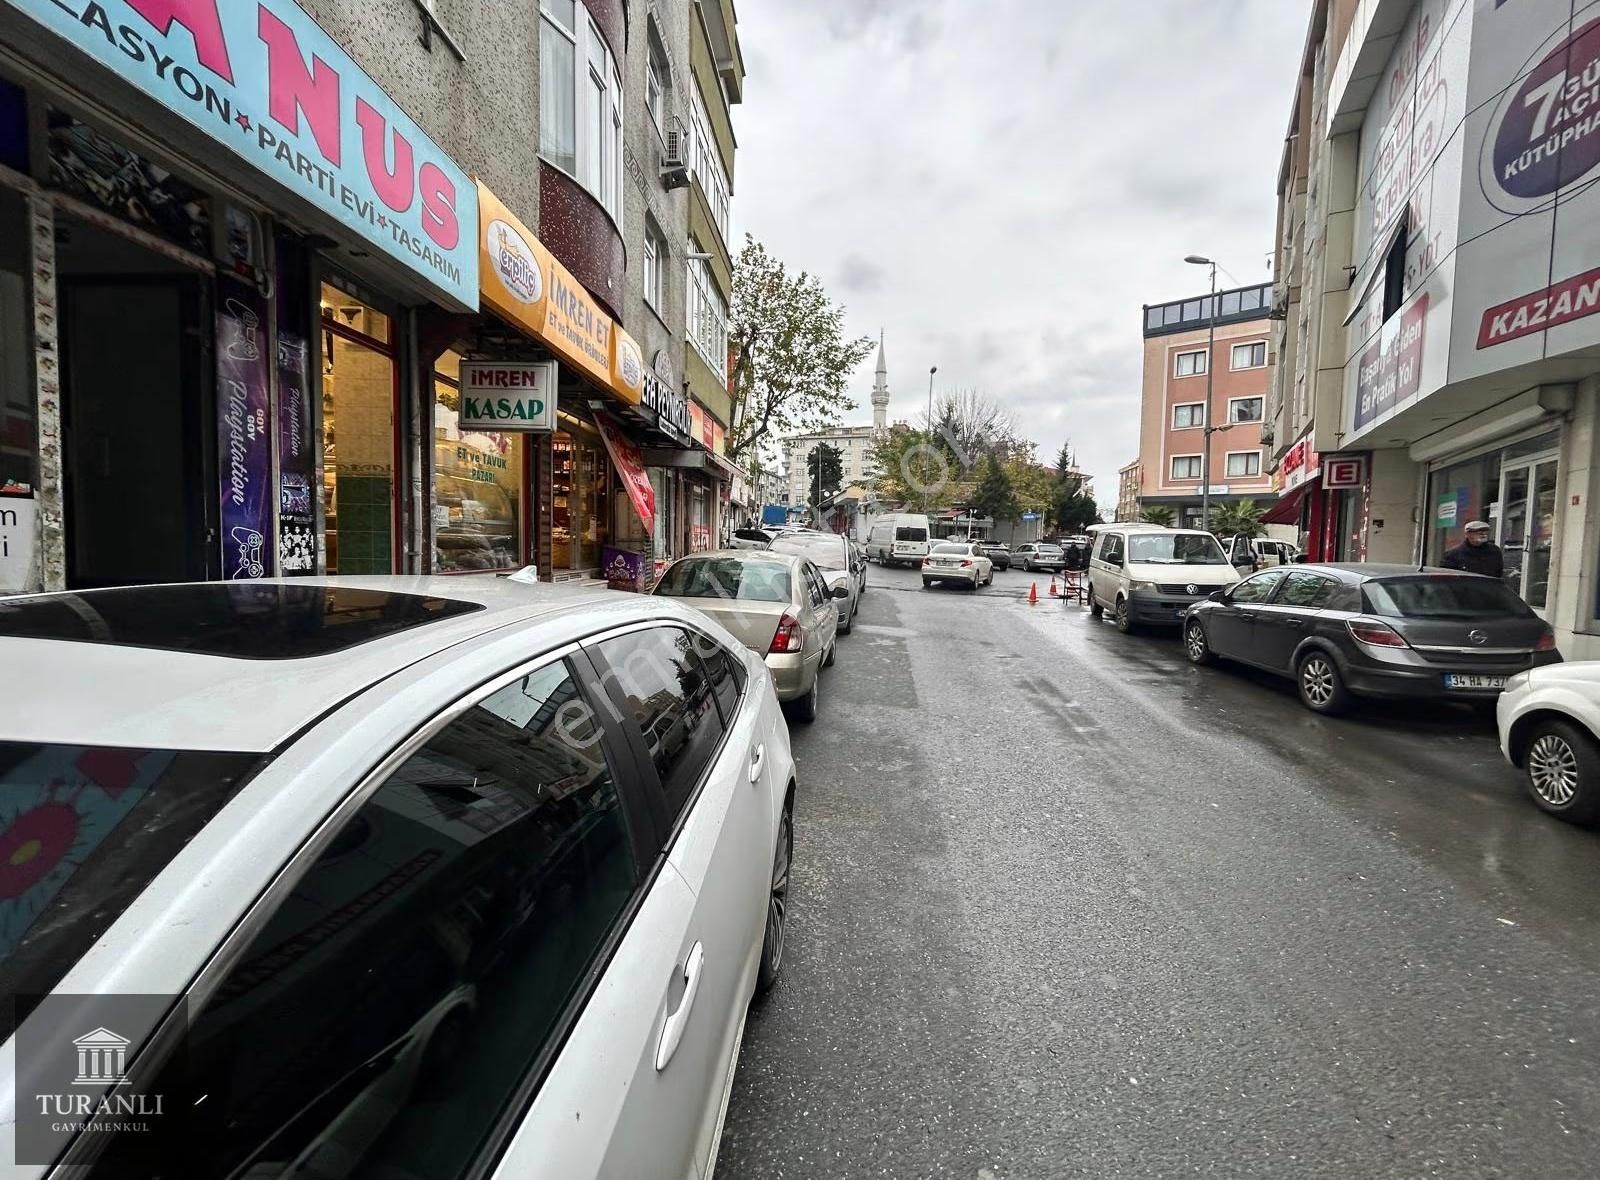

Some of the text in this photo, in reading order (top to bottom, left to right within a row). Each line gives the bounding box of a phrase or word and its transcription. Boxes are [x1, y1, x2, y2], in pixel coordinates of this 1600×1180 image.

[1524, 68, 1567, 143] 7
[258, 125, 336, 197] PARTİ
[341, 188, 375, 221] EVİ
[388, 217, 461, 285] TASARIM
[549, 263, 609, 348] İMREN ET
[1488, 278, 1600, 339] KAZAN
[225, 380, 249, 506] Playstation
[464, 397, 544, 421] KASAP
[457, 446, 507, 469] ET ve TAVUK
[1452, 675, 1466, 686] 34
